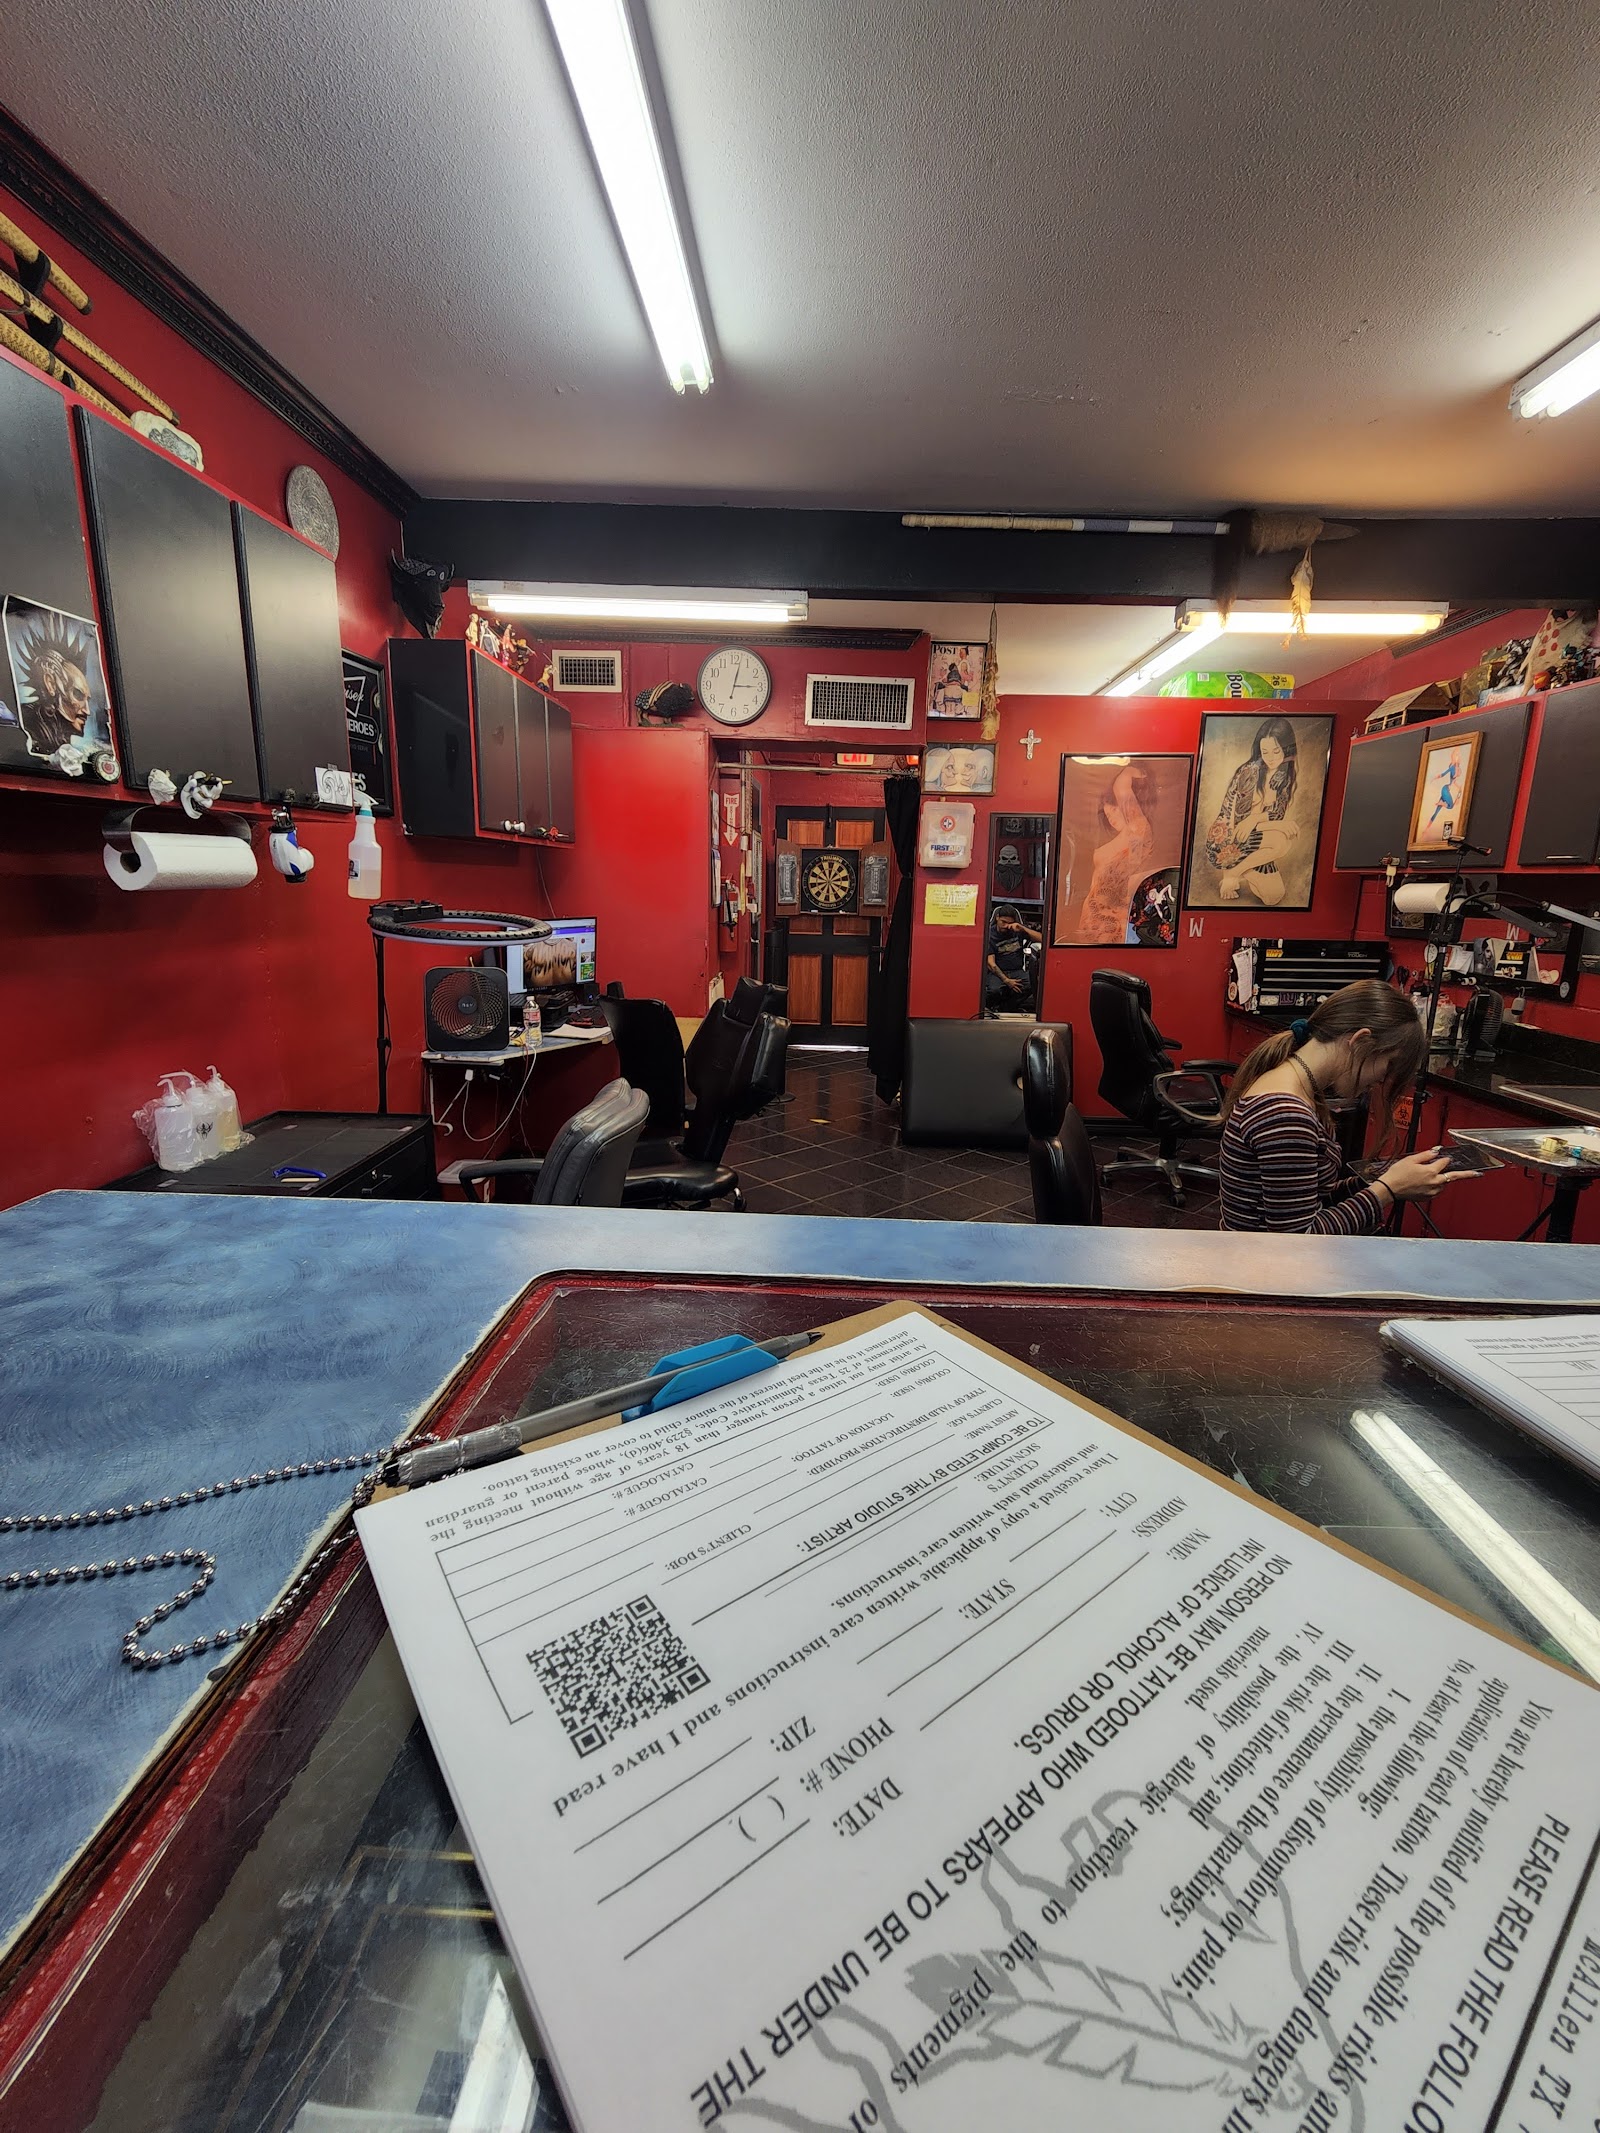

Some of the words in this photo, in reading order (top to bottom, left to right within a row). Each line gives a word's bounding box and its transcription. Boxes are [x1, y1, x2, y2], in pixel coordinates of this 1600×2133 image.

[719, 658, 727, 668] 11
[731, 655, 740, 665] 12
[745, 658, 749, 668] 1
[933, 644, 957, 654] POST
[706, 680, 711, 690] 9
[711, 668, 719, 678] 10
[753, 668, 759, 678] 2
[757, 682, 763, 692] 3
[709, 694, 715, 703] 8
[719, 703, 724, 713] 7
[731, 707, 736, 717] 6
[743, 704, 749, 714] 5
[752, 695, 758, 705] 4
[725, 797, 738, 805] FIRE
[926, 1402, 957, 1419] VALID
[952, 1396, 967, 1407] OF
[962, 1386, 988, 1402] TYPE
[846, 1411, 896, 1438] LOCATION
[857, 1413, 932, 1453] IDENTIFICATION
[945, 1414, 969, 1429] AGE:
[963, 1422, 995, 1441] NAME:
[989, 1407, 1020, 1428] ARTIST
[1008, 1423, 1031, 1438] BE
[1024, 1416, 1047, 1429] TO
[789, 1439, 837, 1463] TATTOO:
[834, 1432, 850, 1445] OF
[944, 1432, 1015, 1473] COMPLETED
[1075, 1442, 1100, 1461] and
[805, 1446, 862, 1477] PROVIDED:
[972, 1441, 1043, 1483] SIGNATURE:
[1081, 1456, 1113, 1476] have
[1105, 1451, 1120, 1462] I
[1286, 1460, 1304, 1477] Goo
[900, 1476, 933, 1498] THE
[927, 1467, 951, 1484] BY
[1018, 1455, 1081, 1497] understand
[1037, 1471, 1086, 1507] received
[1298, 1462, 1321, 1487] Tattoo
[852, 1490, 906, 1524] STUDIO
[991, 1490, 1022, 1512] such
[1027, 1500, 1041, 1511] a
[1098, 1491, 1139, 1519] CITY:
[1130, 1494, 1189, 1539] ADDRESS:
[795, 1516, 855, 1554] ARTIST:
[947, 1508, 996, 1541] written
[984, 1525, 1002, 1543] of
[999, 1507, 1031, 1531] copy
[663, 1549, 700, 1572] DOB:
[917, 1536, 950, 1559] care
[918, 1534, 988, 1583] applicable
[1164, 1527, 1213, 1562] NAME:
[829, 1554, 924, 1610] instructions.
[1191, 1537, 1267, 1602] INFLUENCE
[1263, 1553, 1293, 1577] NO
[864, 1579, 922, 1616] written
[957, 1577, 1017, 1621] STATE:
[1175, 1594, 1203, 1620] OF
[1214, 1569, 1276, 1624] PERSON
[828, 1611, 865, 1639] care
[1187, 1614, 1229, 1653] MAY
[1294, 1621, 1324, 1645] IV.
[1104, 1609, 1183, 1676] ALCOHOL
[1163, 1642, 1199, 1673] BE
[1214, 1625, 1271, 1679] materials
[1274, 1644, 1302, 1667] the
[1324, 1639, 1355, 1664] III.
[724, 1634, 832, 1708] instructions
[1303, 1663, 1332, 1688] the
[1354, 1662, 1383, 1684] II.
[1446, 1658, 1477, 1675] to,
[1078, 1671, 1115, 1702] OR
[1183, 1675, 1223, 1712] used.
[1212, 1663, 1278, 1733] possibility
[1282, 1682, 1314, 1714] risk
[1334, 1683, 1364, 1709] the
[1386, 1687, 1412, 1704] I.
[1441, 1674, 1463, 1696] at
[681, 1702, 723, 1738] and
[1084, 1664, 1179, 1748] TATTOOED
[1270, 1708, 1291, 1735] of
[1367, 1705, 1398, 1731] the
[1422, 1688, 1460, 1727] least
[1454, 1676, 1509, 1753] application
[1518, 1699, 1554, 1731] You
[665, 1728, 682, 1749] I
[769, 1714, 818, 1754] ZIP:
[1012, 1691, 1092, 1756] DRUGS.
[1407, 1719, 1438, 1747] the
[610, 1738, 667, 1778] have
[818, 1715, 897, 1782] PHONE
[1195, 1733, 1217, 1761] of
[1210, 1722, 1285, 1794] infection;
[1271, 1699, 1345, 1790] permanence
[1504, 1727, 1532, 1757] are
[1039, 1739, 1096, 1791] WHO
[1313, 1722, 1379, 1804] possibility
[1445, 1749, 1470, 1777] of
[551, 1772, 608, 1819] read
[1138, 1754, 1197, 1816] allergic
[1356, 1742, 1426, 1821] following:
[1423, 1766, 1458, 1808] each
[1470, 1752, 1525, 1812] hereby
[831, 1775, 905, 1838] DATE:
[1187, 1787, 1222, 1832] and
[1257, 1785, 1281, 1816] of
[1303, 1798, 1327, 1830] of
[941, 1779, 1046, 1887] APPEARS
[1235, 1803, 1270, 1837] the
[1391, 1802, 1440, 1856] tattoo.
[1066, 1816, 1139, 1894] reaction
[1440, 1806, 1490, 1885] notified
[1511, 1812, 1571, 1906] PLEASE
[1159, 1829, 1246, 1929] markings;
[1234, 1816, 1317, 1919] discomfort
[905, 1877, 951, 1921] TO
[1355, 1862, 1410, 1922] These
[1428, 1875, 1457, 1911] of
[1040, 1897, 1069, 1926] to
[1217, 1910, 1245, 1944] or
[1409, 1897, 1447, 1938] the
[863, 1909, 912, 1964] BE
[998, 1929, 1040, 1972] the
[1329, 1915, 1370, 1967] risk
[1482, 1895, 1535, 1973] READ
[1170, 1927, 1227, 2001] pain;
[1361, 1924, 1423, 2028] possible
[760, 1950, 871, 2060] UNDER
[1302, 1958, 1342, 2020] and
[1455, 1968, 1506, 2036] THE
[889, 1965, 996, 2095] pigments
[1240, 2005, 1319, 2116] dangers
[1326, 2021, 1379, 2097] risks
[689, 2046, 768, 2131] THE
[1402, 2022, 1480, 2133] FOLLO
[1529, 2063, 1573, 2122] TX
